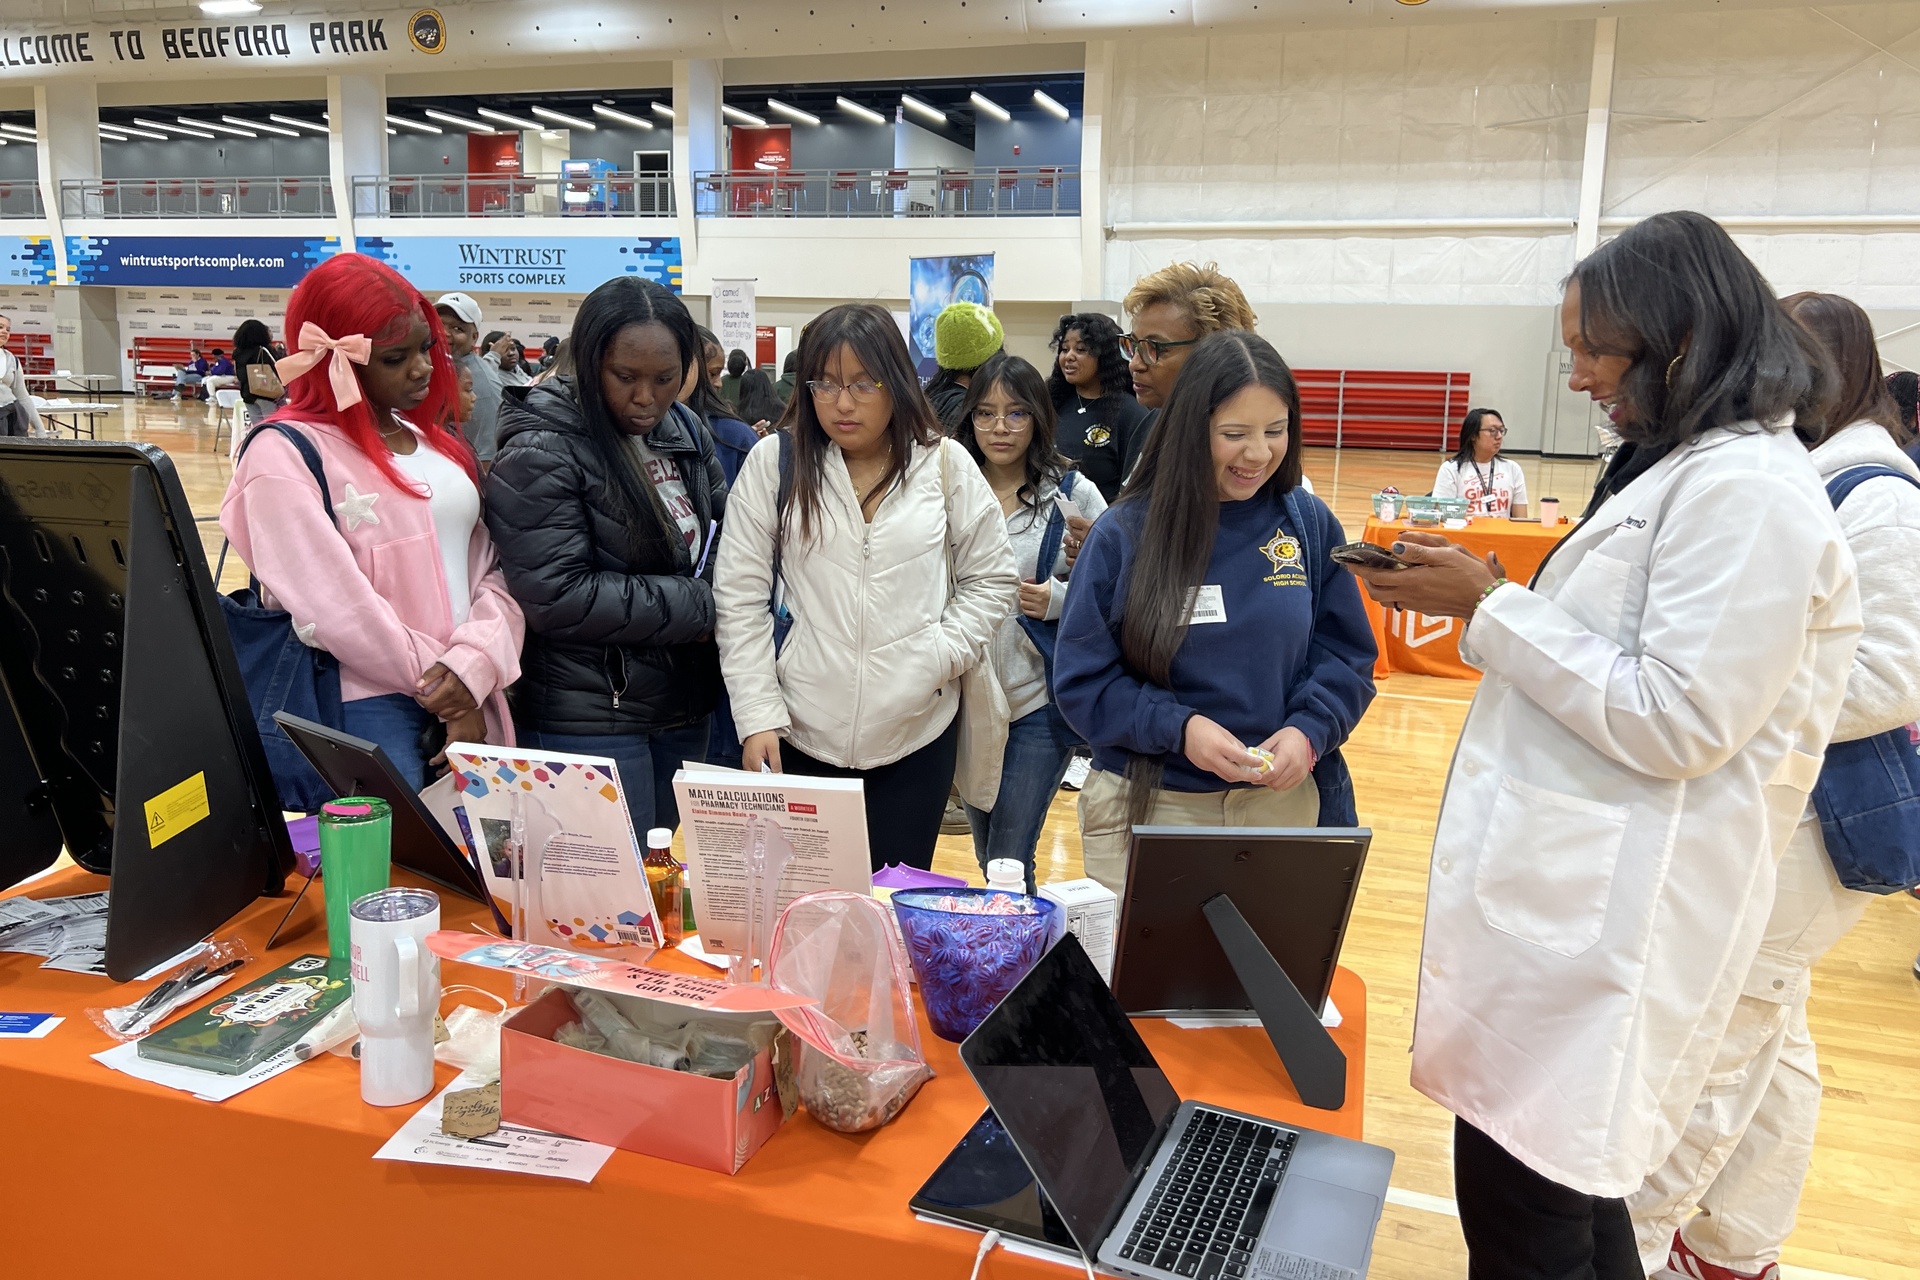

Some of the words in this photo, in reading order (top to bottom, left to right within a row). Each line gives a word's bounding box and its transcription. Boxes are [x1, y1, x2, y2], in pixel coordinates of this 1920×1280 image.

[0, 32, 94, 66] LCOME
[109, 30, 146, 61] TO
[162, 24, 290, 59] BEDFORD
[309, 19, 389, 54] PARK
[119, 253, 285, 271] wintrustsportscomplex.com
[458, 244, 566, 266] WINTRUST
[459, 273, 504, 285] SPORTS
[508, 273, 566, 285] COMPLEX
[723, 310, 740, 319] Become
[741, 310, 749, 319] the
[723, 320, 737, 329] Future
[742, 320, 751, 329] the
[736, 330, 751, 340] Energy
[1465, 487, 1497, 500] Girs
[1501, 488, 1509, 497] in
[1467, 498, 1509, 513] STEM
[1263, 573, 1291, 582] SOLORIO
[687, 788, 714, 801] MATH
[717, 791, 785, 804] CALCULATIONS
[700, 801, 739, 810] PHARMACY
[741, 803, 786, 813] TECHNICIANS
[297, 958, 320, 970] 30
[627, 967, 672, 978] Hand
[675, 976, 728, 990] Cream
[644, 977, 670, 985] Lip
[674, 983, 718, 995] Balm
[635, 983, 667, 993] Gift
[669, 989, 706, 1001] Sets
[234, 1003, 257, 1015] LIP
[255, 986, 293, 1004] BALM
